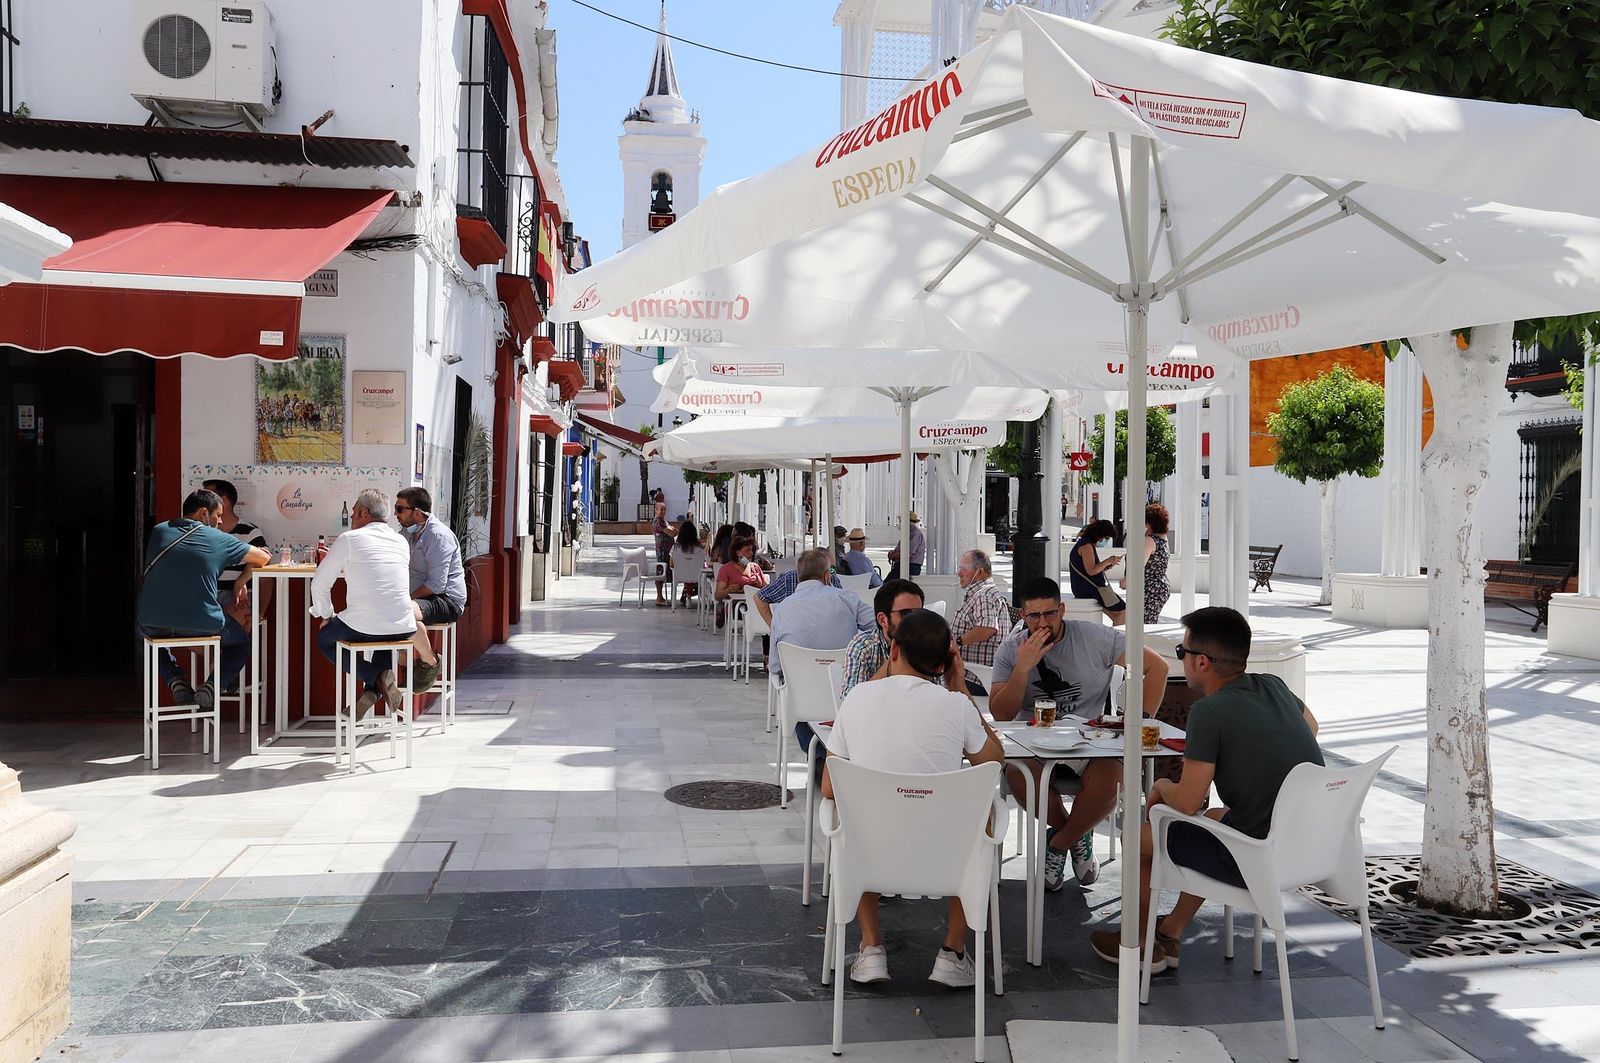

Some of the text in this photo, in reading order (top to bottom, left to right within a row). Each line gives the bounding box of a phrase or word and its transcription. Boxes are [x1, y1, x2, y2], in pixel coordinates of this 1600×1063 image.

[1147, 102, 1159, 110] TELA
[1160, 102, 1173, 112] ESTÁ
[1173, 105, 1192, 115] HECHA
[1193, 107, 1206, 116] CON
[1213, 109, 1240, 119] BOTELLAS
[1156, 111, 1182, 123] PLÁSTICO
[1195, 117, 1230, 128] RECICLADAS
[304, 283, 335, 292] AGUNA
[298, 347, 341, 358] NALIEGA
[919, 426, 988, 438] Cruzcampo
[897, 787, 933, 795] Cruzcampo
